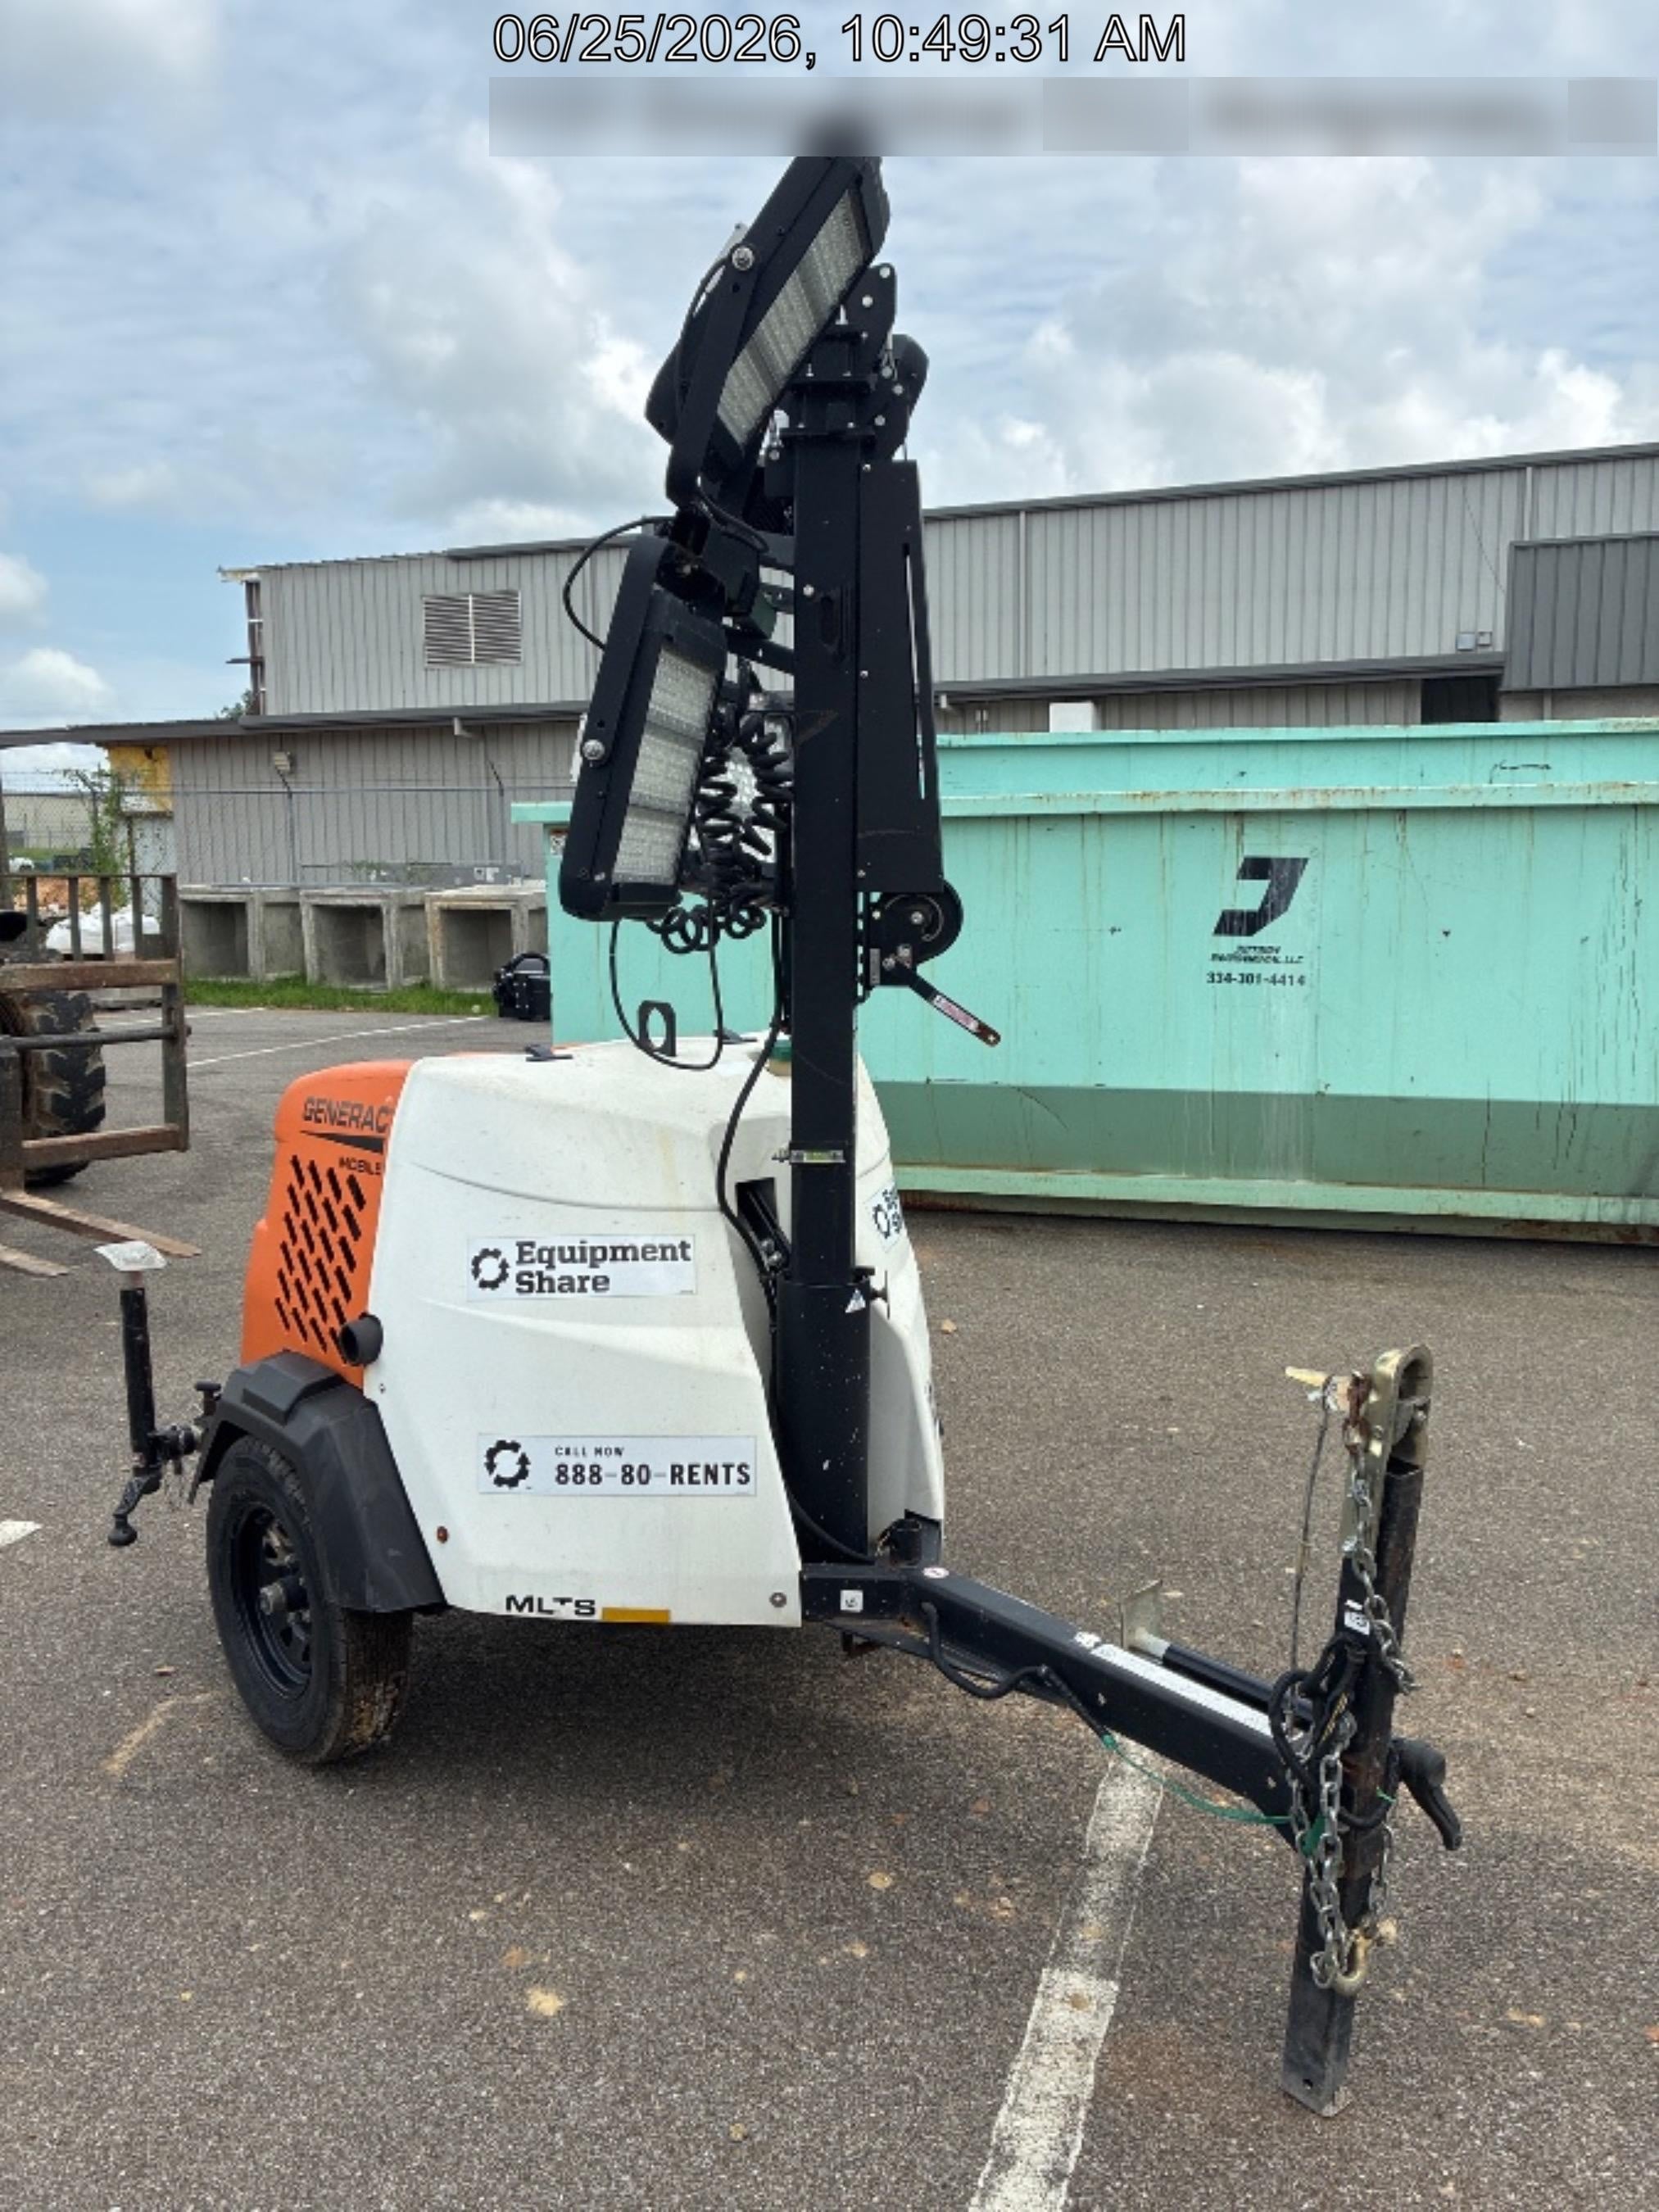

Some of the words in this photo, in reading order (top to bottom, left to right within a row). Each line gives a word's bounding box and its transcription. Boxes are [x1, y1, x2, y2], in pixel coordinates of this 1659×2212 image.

[303, 1095, 395, 1133] GENERAC
[338, 1156, 381, 1176] MOBILE
[515, 1240, 691, 1270] Equipment
[515, 1270, 610, 1294] Share
[555, 1463, 750, 1485] 888-80-RENTS
